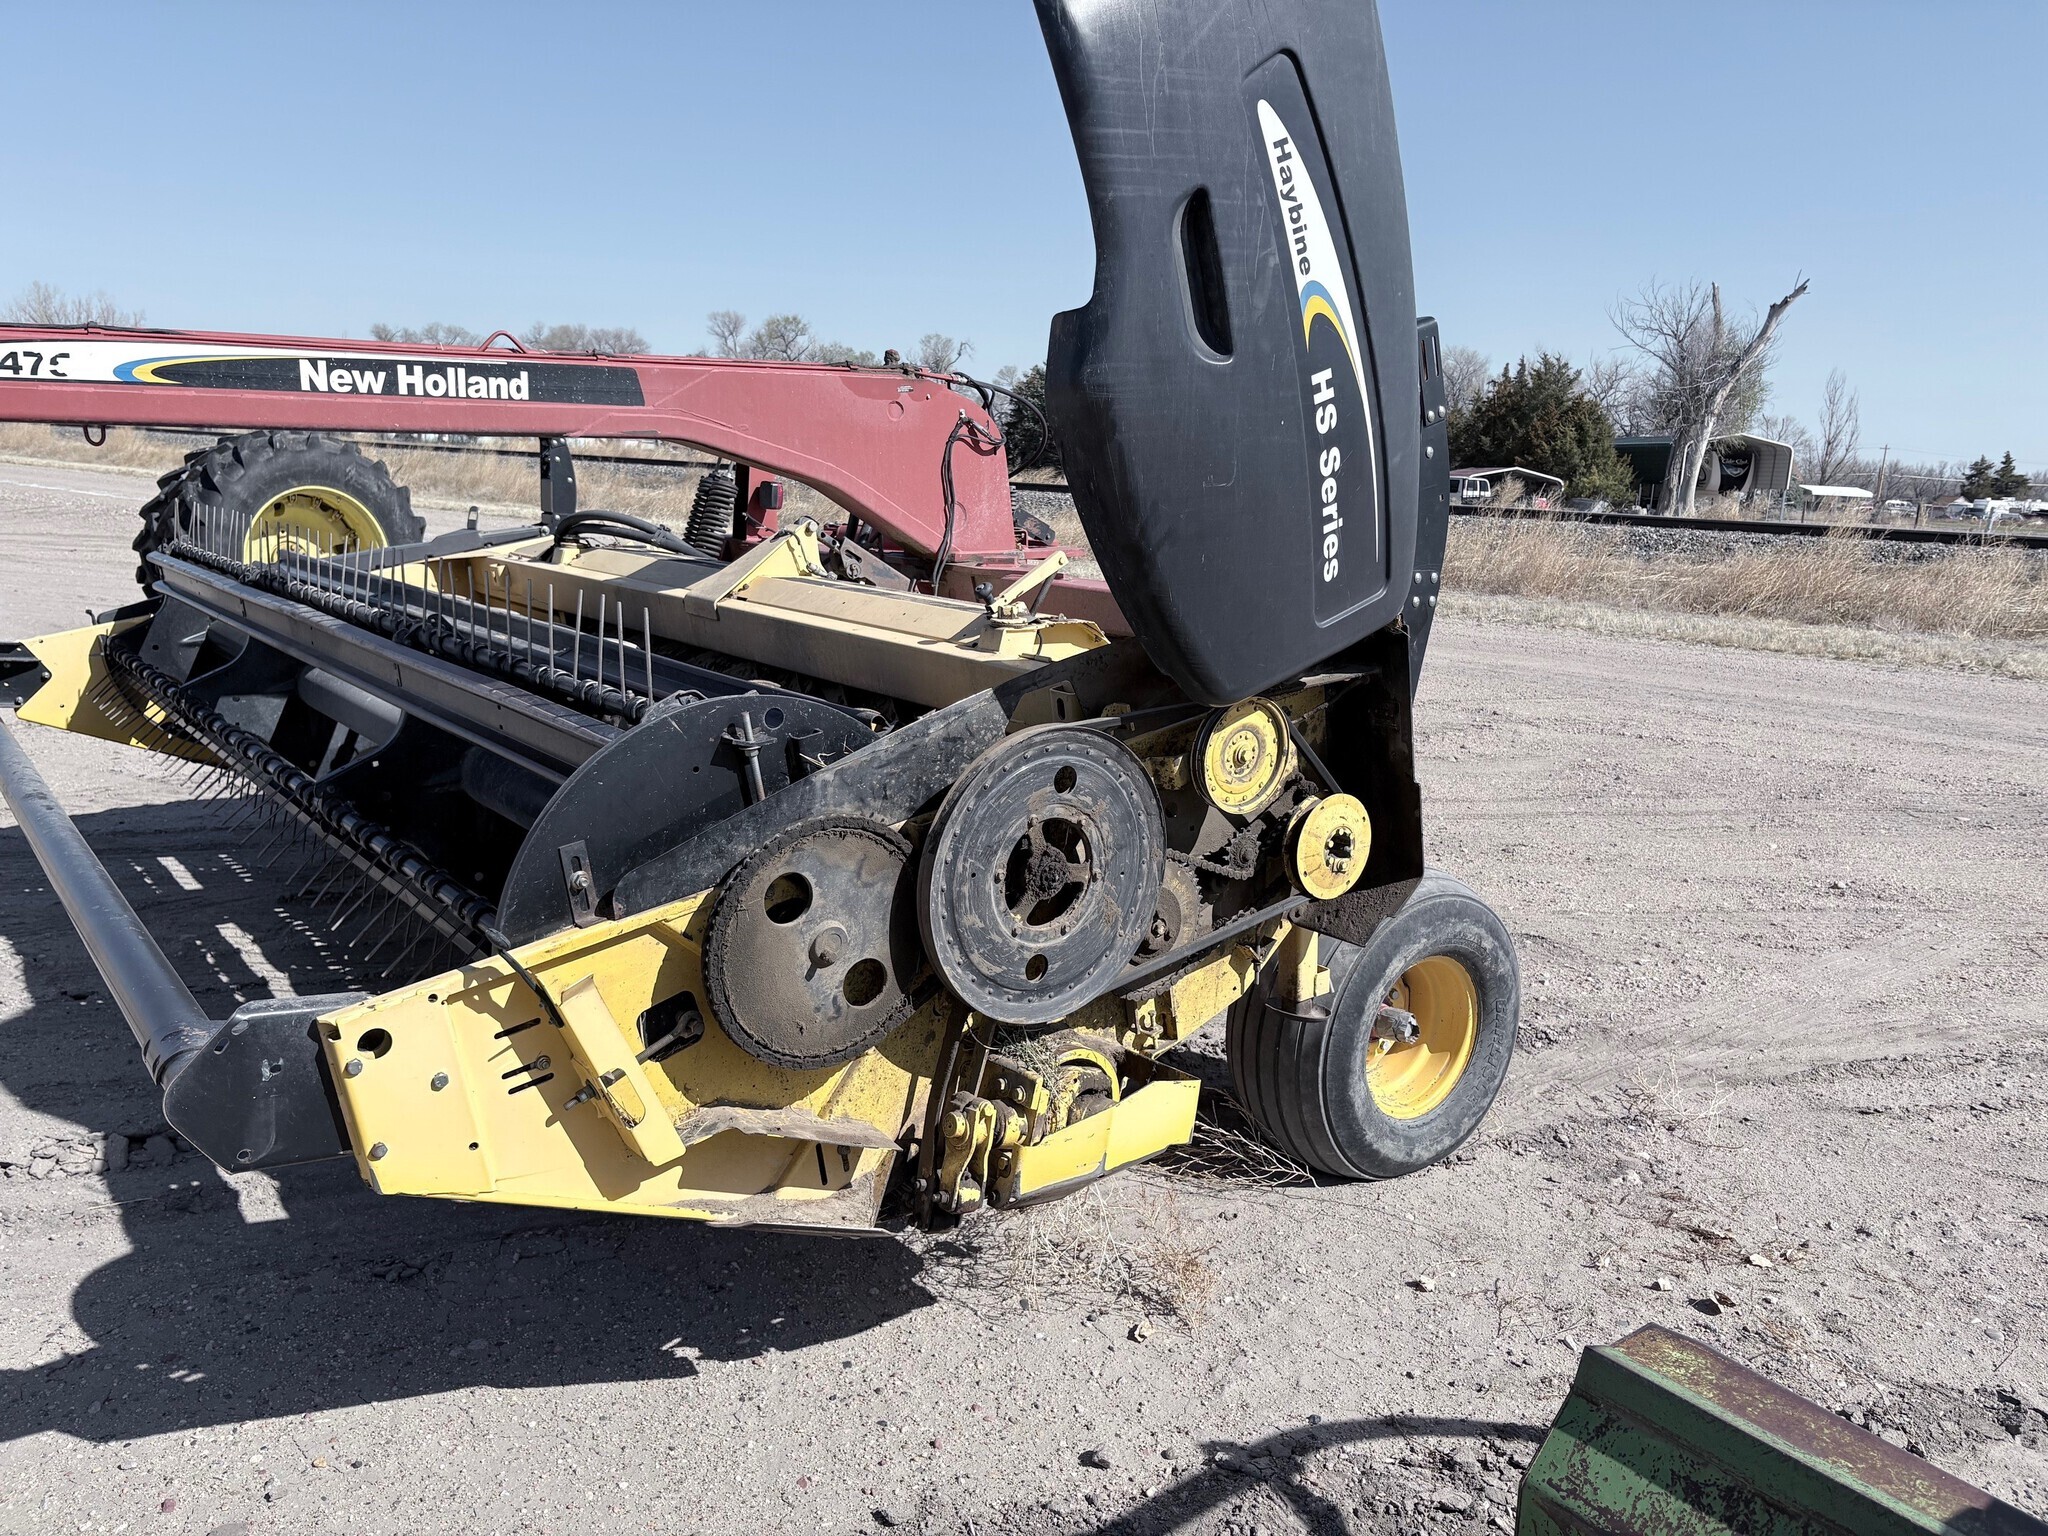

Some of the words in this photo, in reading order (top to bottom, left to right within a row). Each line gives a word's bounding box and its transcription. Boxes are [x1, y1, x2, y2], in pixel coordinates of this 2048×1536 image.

[1273, 136, 1311, 276] Haybine
[299, 359, 387, 394] New
[397, 364, 530, 400] Holland
[1311, 367, 1337, 435] HS
[1319, 446, 1343, 583] Series
